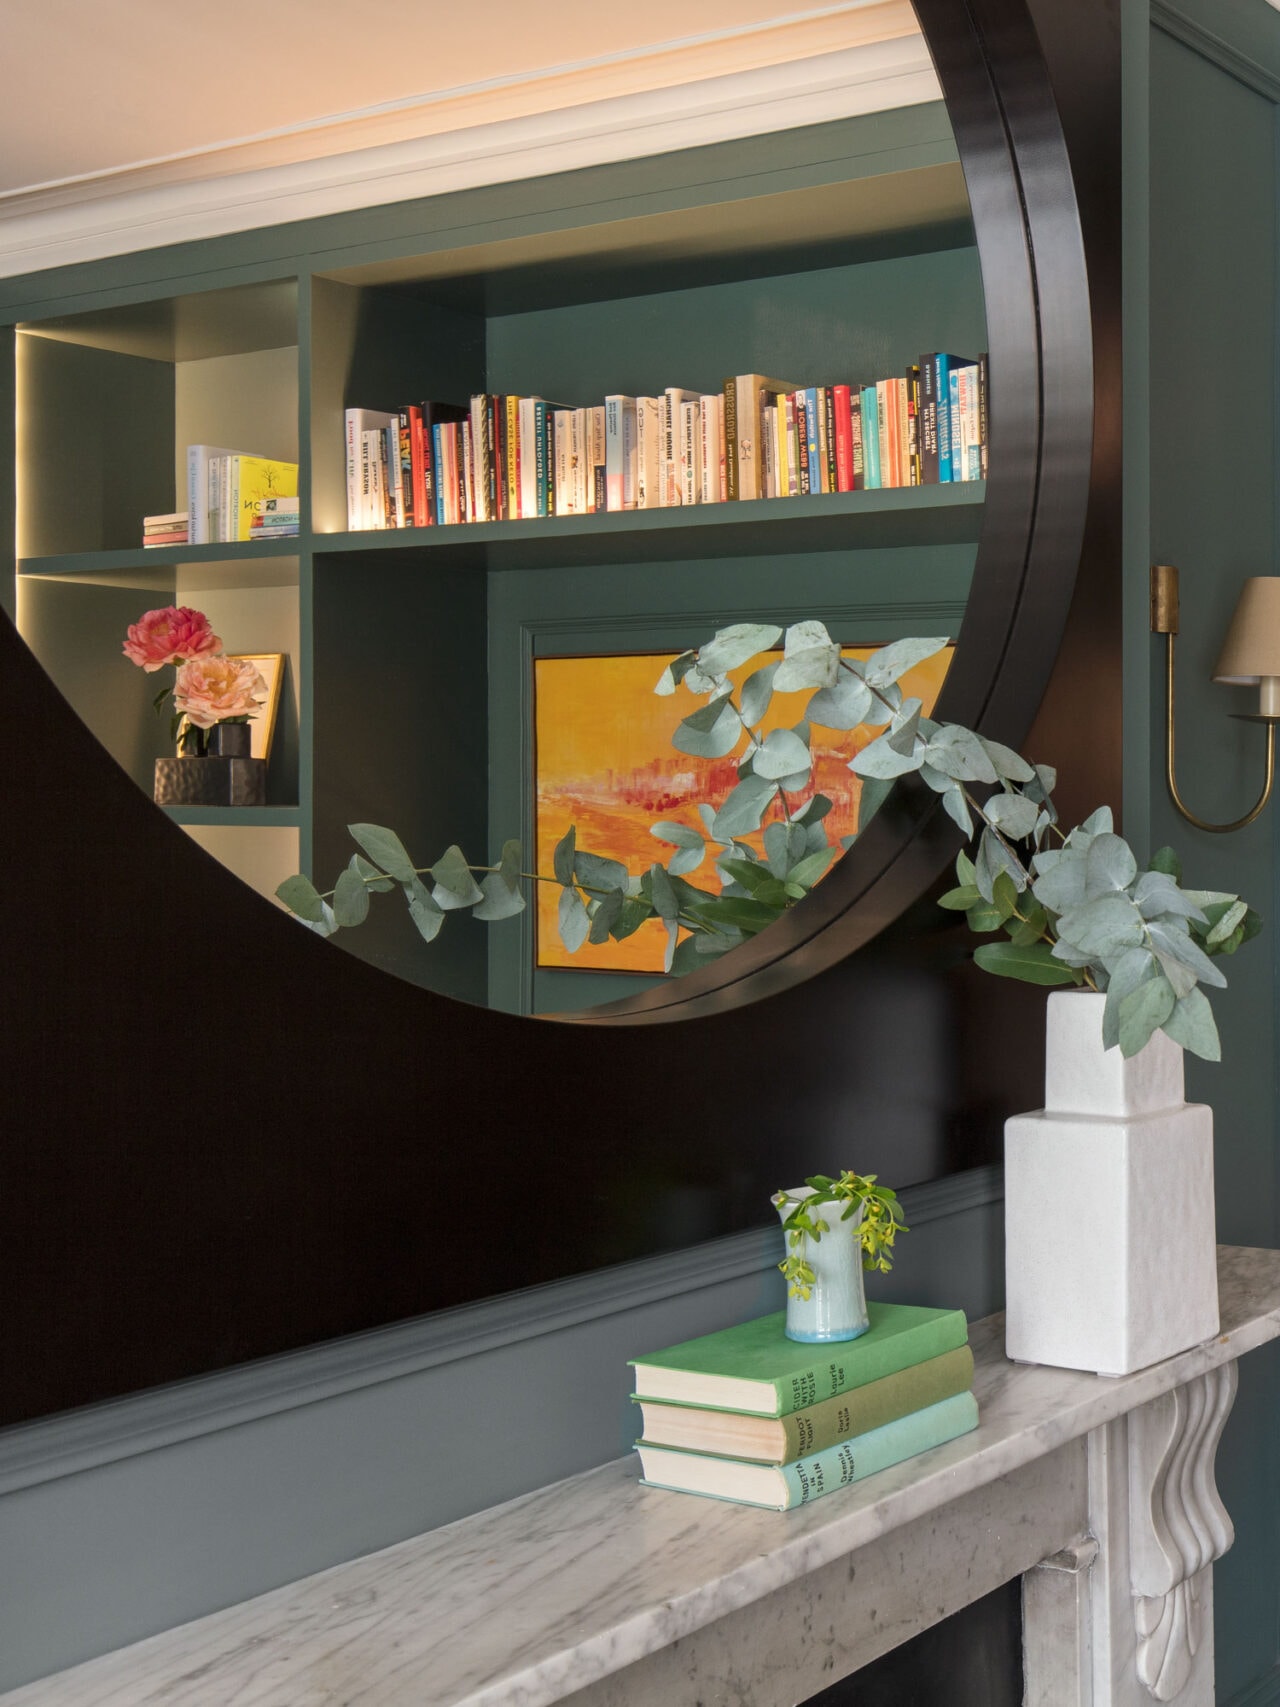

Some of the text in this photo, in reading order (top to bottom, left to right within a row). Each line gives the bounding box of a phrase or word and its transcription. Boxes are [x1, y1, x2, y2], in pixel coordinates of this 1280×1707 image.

[792, 1379, 802, 1411] CIDER
[800, 1378, 810, 1405] WITH
[807, 1372, 817, 1406] ROSIE
[829, 1364, 839, 1397] Laurie
[805, 1416, 814, 1450] FLIGHT
[813, 1463, 825, 1493] SPAIN
[838, 1452, 848, 1483] Dennis
[841, 1445, 856, 1483] Wheatley
[795, 1462, 809, 1506] VENDETTA
[810, 1476, 817, 1487] IN
